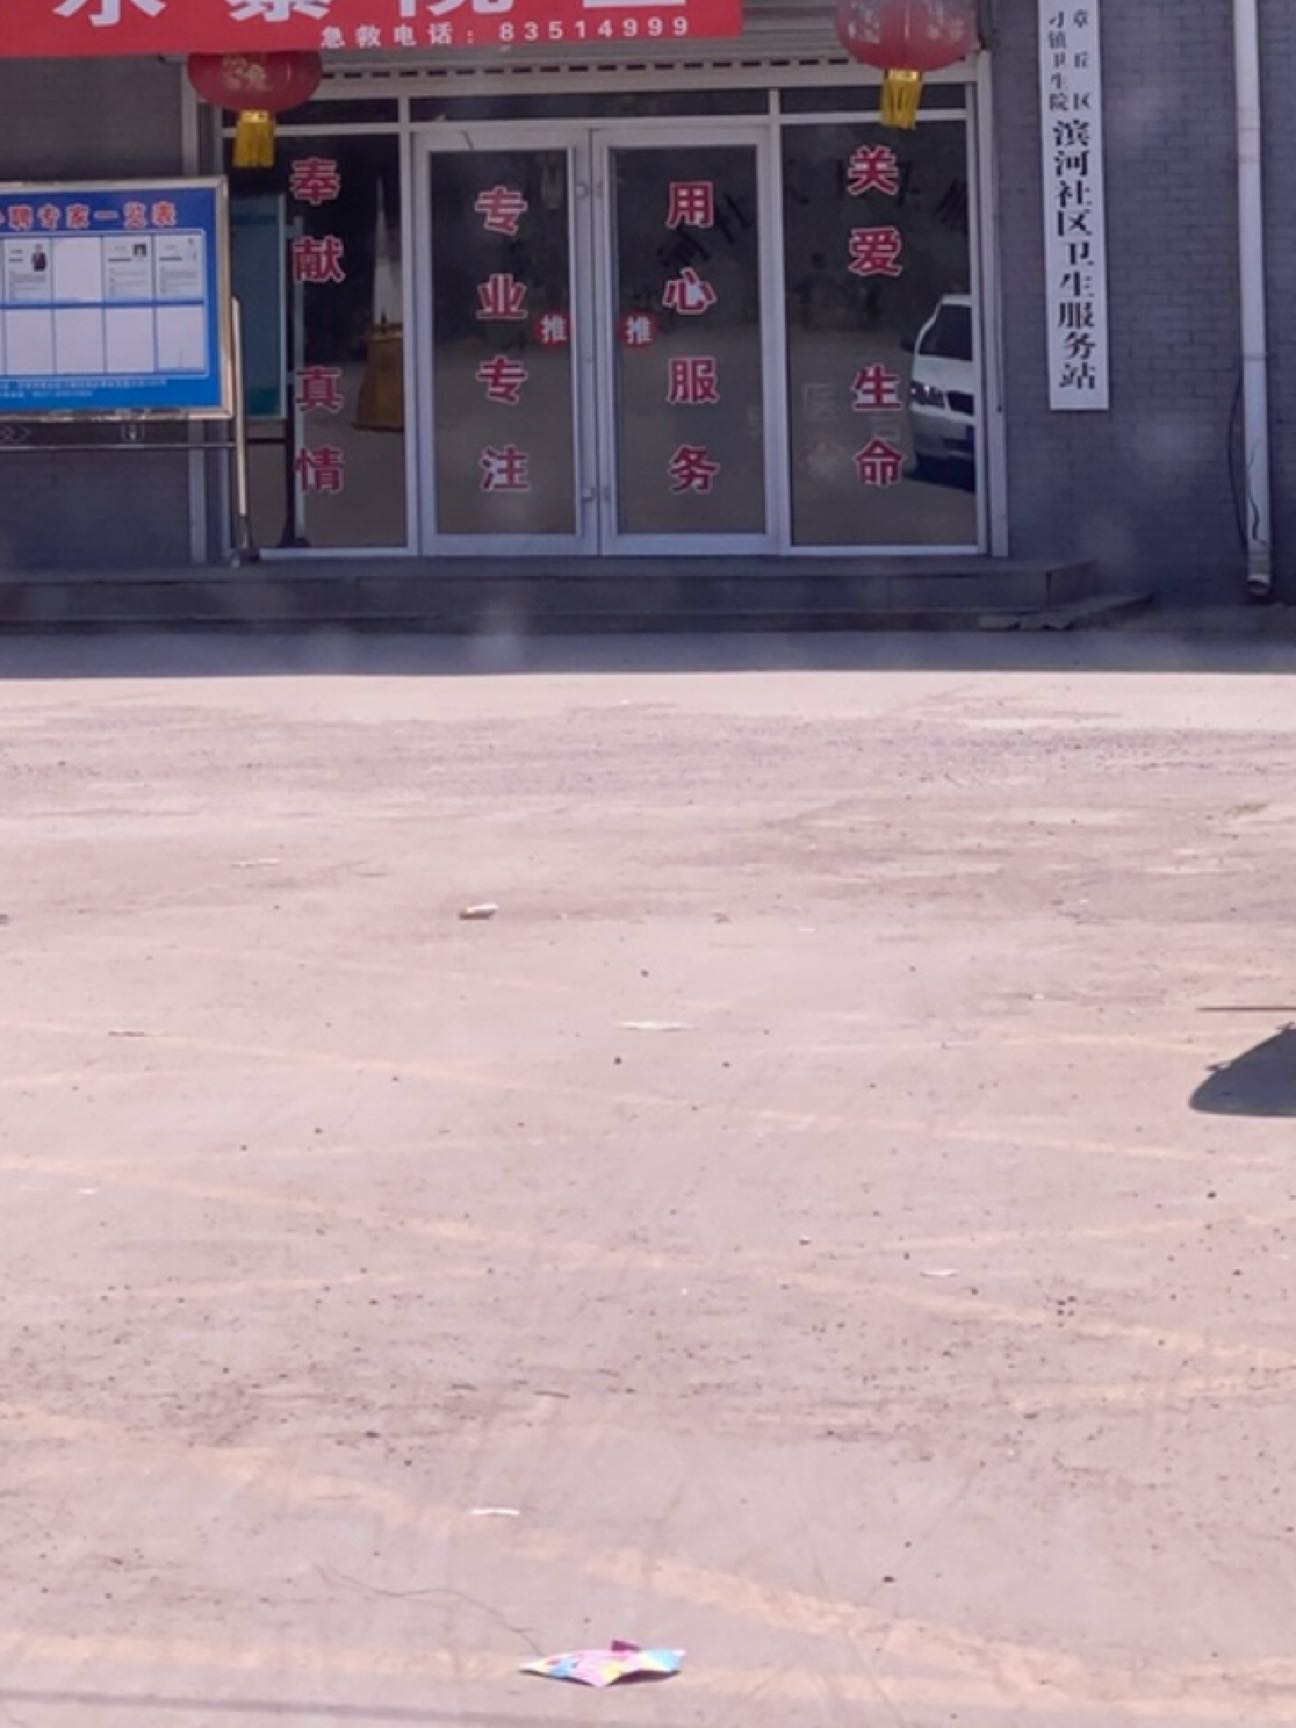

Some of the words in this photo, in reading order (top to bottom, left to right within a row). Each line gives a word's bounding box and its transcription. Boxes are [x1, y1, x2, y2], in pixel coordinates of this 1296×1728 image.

[289, 157, 346, 494] 奉献真情
[474, 185, 531, 493] 专业专注
[540, 314, 569, 344] 推
[625, 314, 653, 345] 推
[661, 180, 720, 493] 用心服务
[846, 144, 904, 488] 关爱生命
